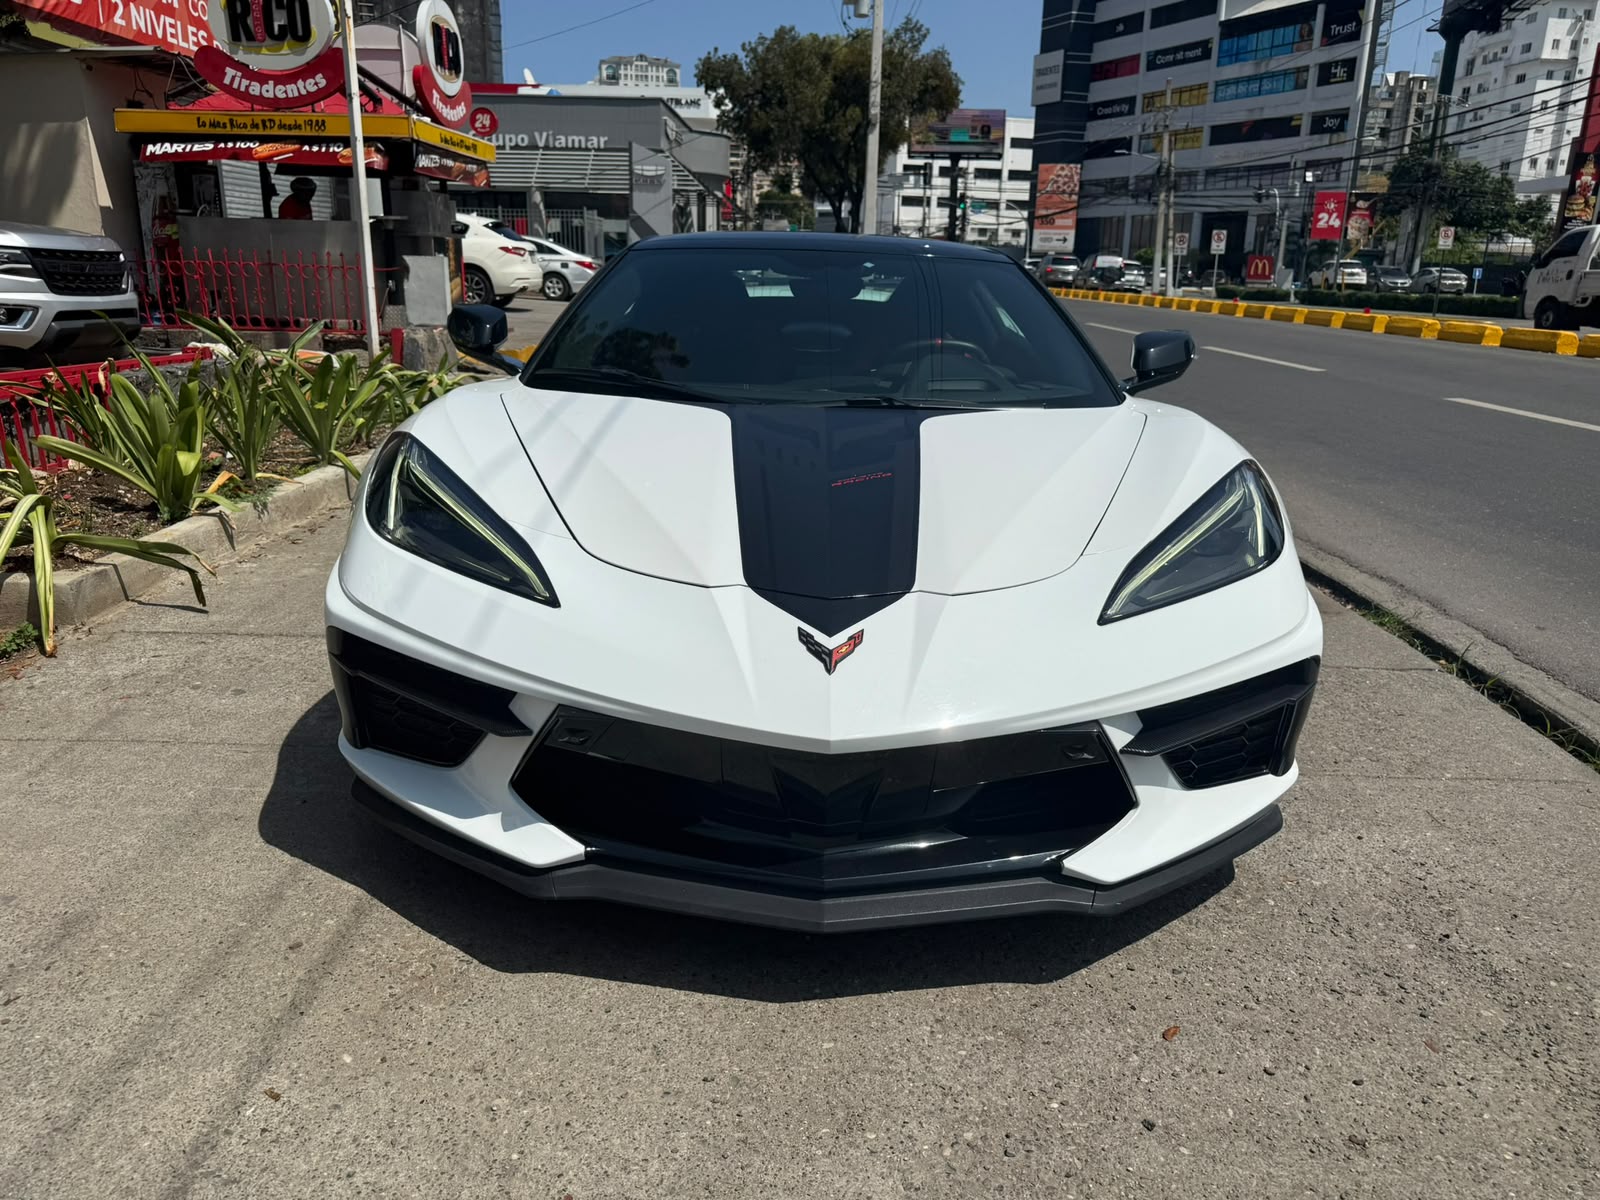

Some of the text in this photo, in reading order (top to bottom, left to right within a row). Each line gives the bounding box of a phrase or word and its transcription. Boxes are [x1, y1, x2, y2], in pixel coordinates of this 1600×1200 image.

[111, 0, 126, 26] 2
[130, 3, 208, 51] NIVELES
[1330, 21, 1357, 36] Trust
[222, 67, 327, 99] Tiradentes
[229, 118, 248, 131] Rico
[249, 118, 260, 130] de
[262, 118, 276, 131] RD
[277, 118, 302, 131] desde
[303, 119, 327, 132] 1988
[474, 113, 491, 128] 24
[1322, 116, 1341, 129] Joy
[534, 131, 608, 150] Viamar
[145, 141, 215, 156] MARTES
[1316, 212, 1341, 228] 24
